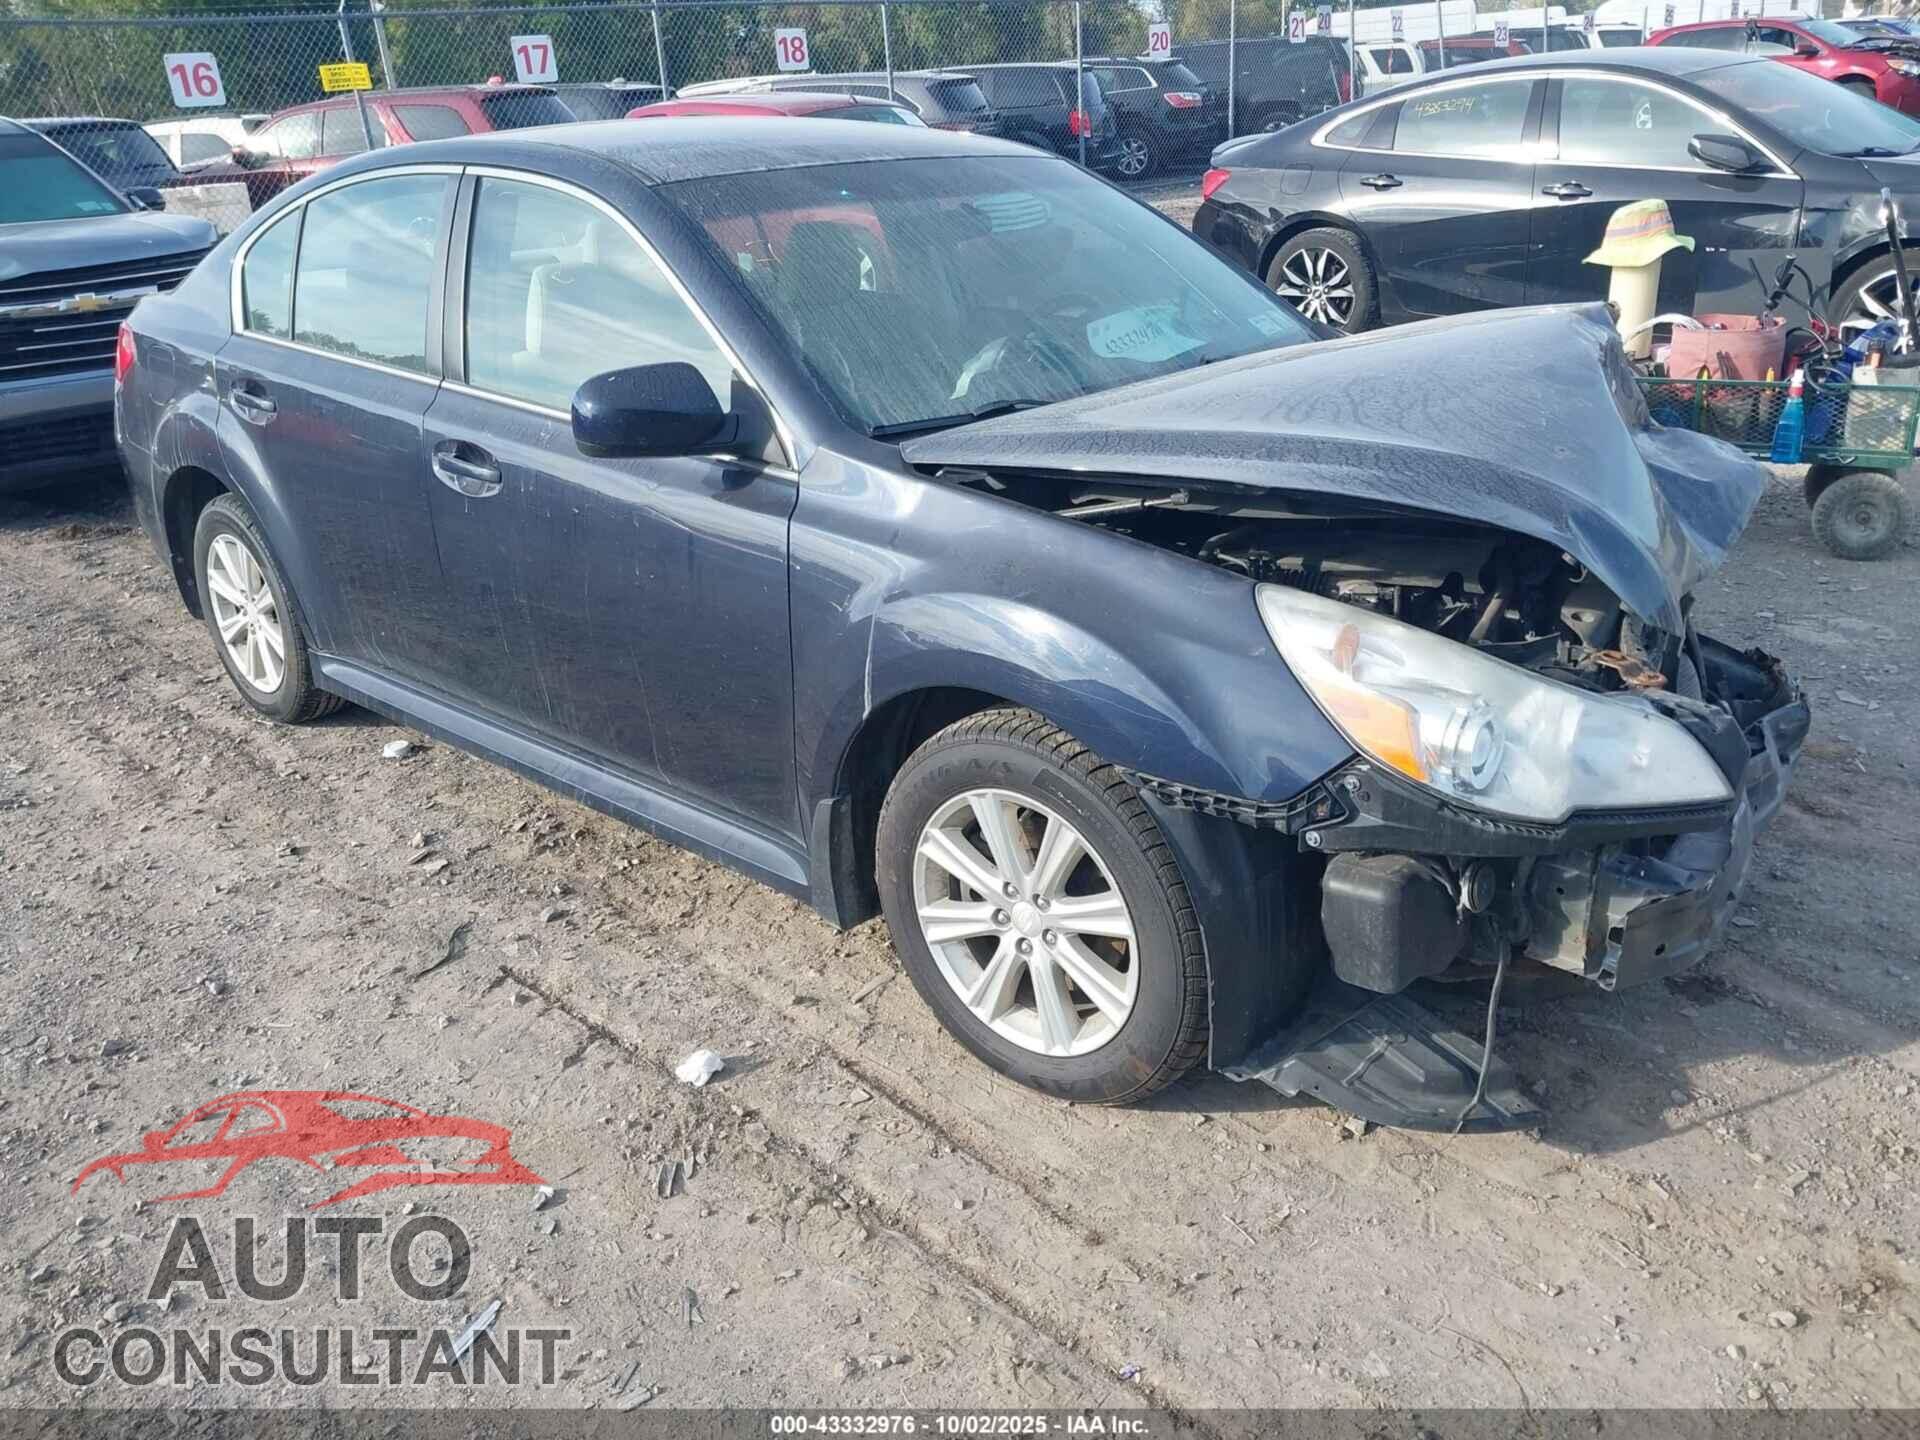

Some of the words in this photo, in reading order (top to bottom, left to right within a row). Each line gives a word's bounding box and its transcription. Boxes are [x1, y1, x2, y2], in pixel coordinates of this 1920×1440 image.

[1291, 17, 1305, 38] 21
[1318, 12, 1331, 30] 20
[1392, 16, 1403, 32] 22
[1151, 31, 1168, 51] 20
[1495, 26, 1507, 41] 23
[517, 44, 549, 74] 17
[779, 36, 805, 63] 18
[171, 62, 218, 97] 16
